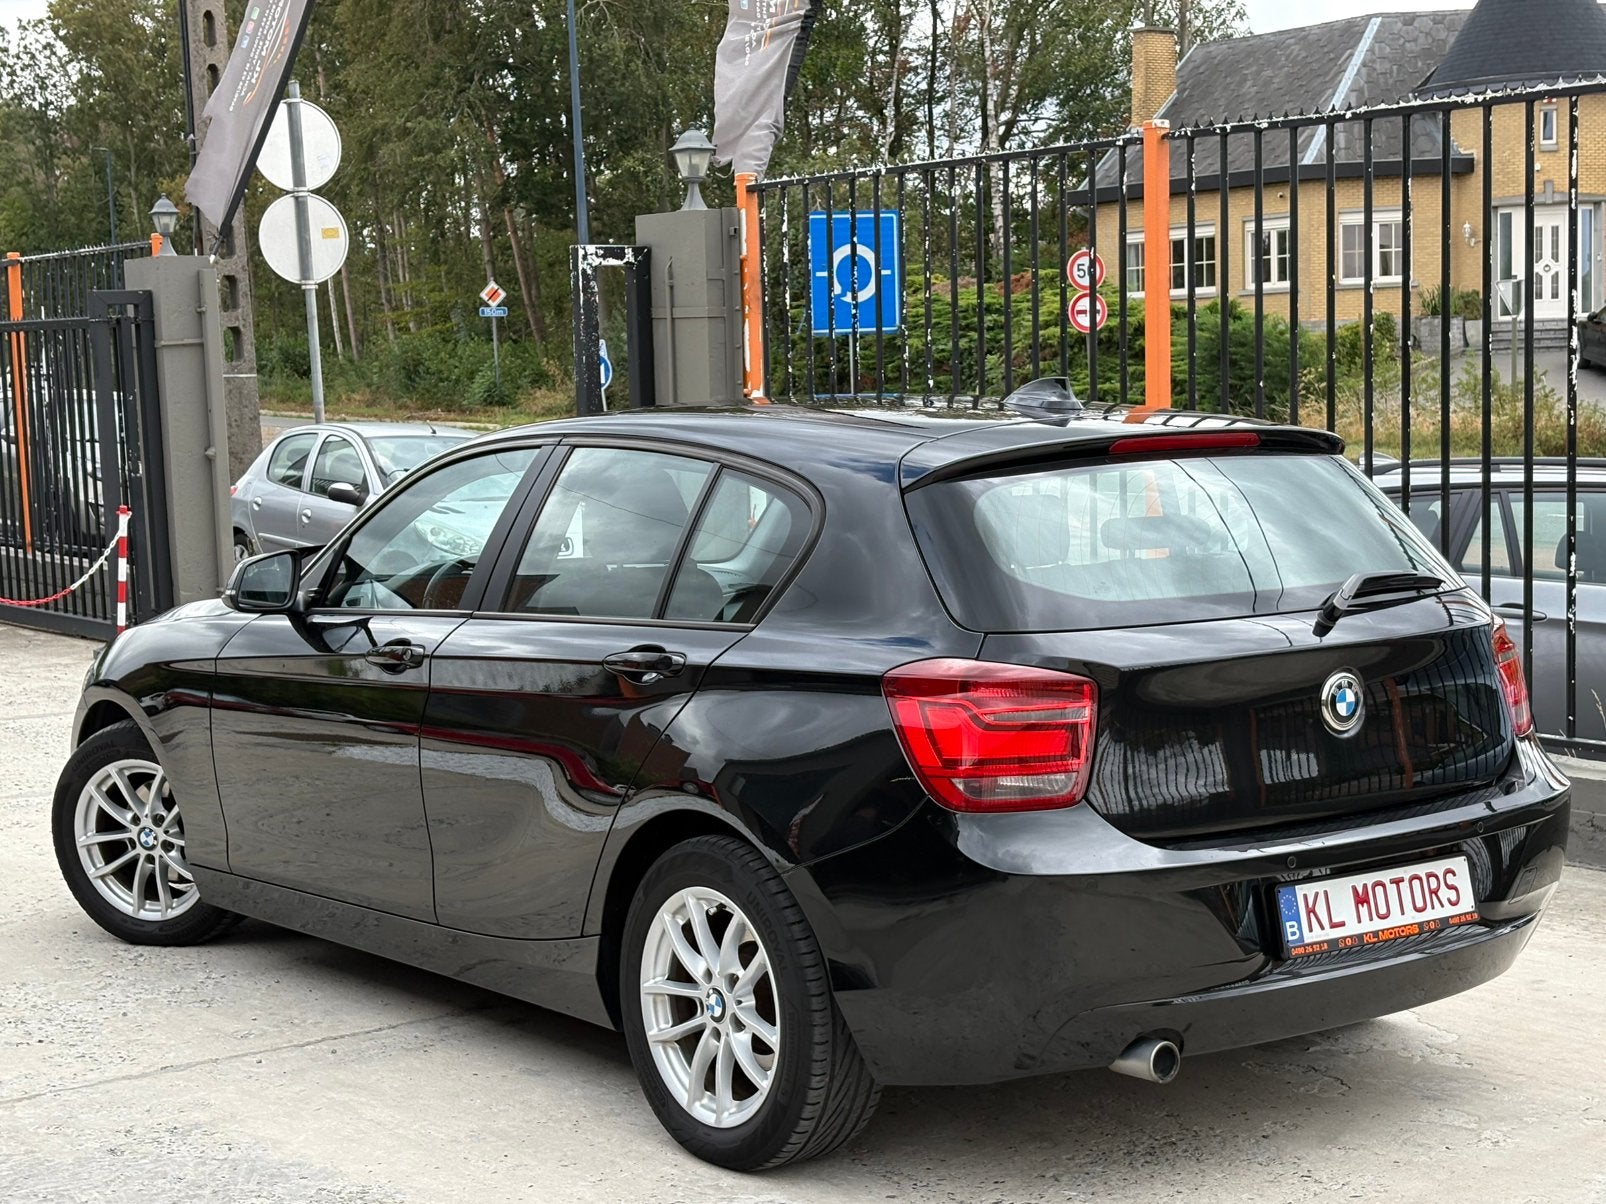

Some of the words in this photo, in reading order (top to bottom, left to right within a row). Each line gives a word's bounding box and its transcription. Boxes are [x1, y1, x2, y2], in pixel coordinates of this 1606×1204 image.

[484, 308, 504, 316] 150m
[1302, 889, 1346, 933] KL
[1351, 867, 1461, 924] MOTORS
[746, 891, 788, 978] UNIROYAL
[1286, 920, 1300, 940] B
[1363, 933, 1378, 943] KL
[1378, 924, 1419, 940] MOTORS
